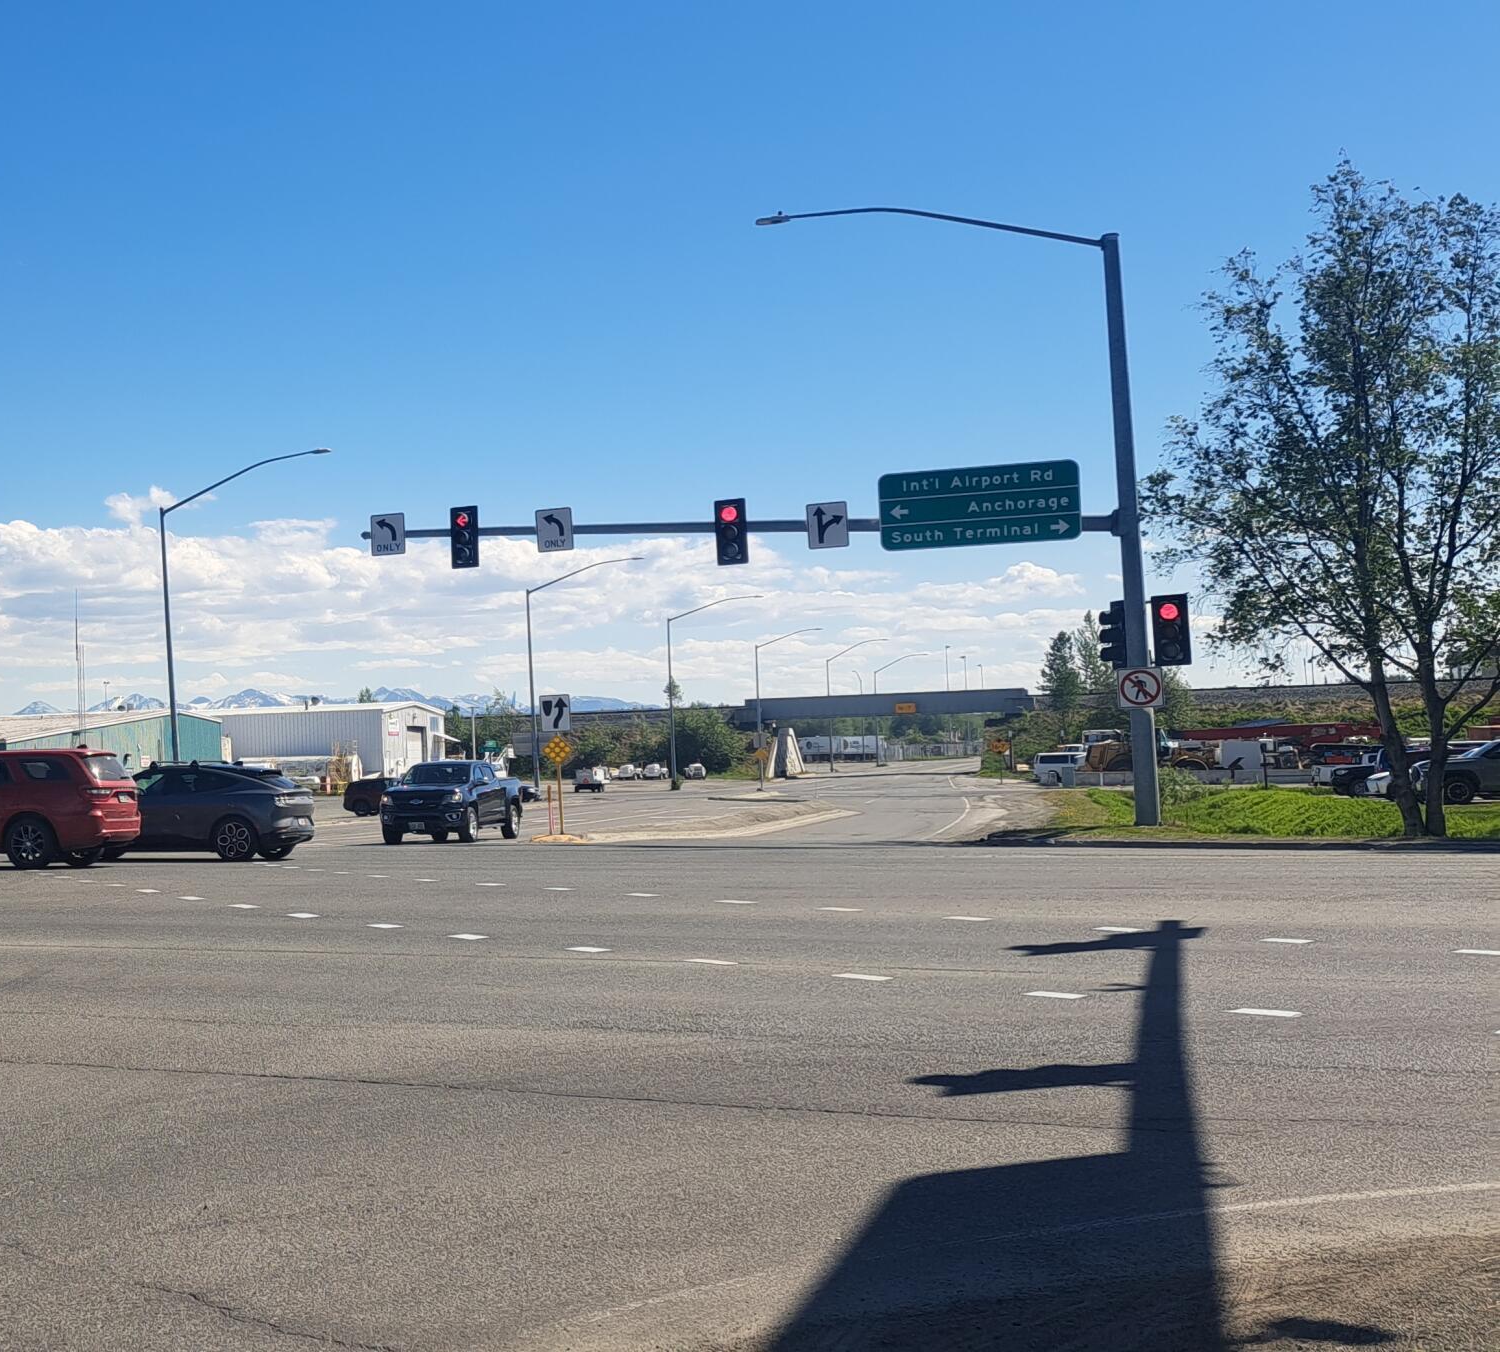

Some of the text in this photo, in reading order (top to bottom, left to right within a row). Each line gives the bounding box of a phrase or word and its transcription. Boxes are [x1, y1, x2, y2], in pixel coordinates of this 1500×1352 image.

[902, 469, 1053, 492] Int'l Airport Rd
[967, 495, 1070, 513] Anchorage
[891, 522, 1039, 544] South Terminal
[376, 542, 401, 552] ONLY
[544, 538, 566, 549] ONLY
